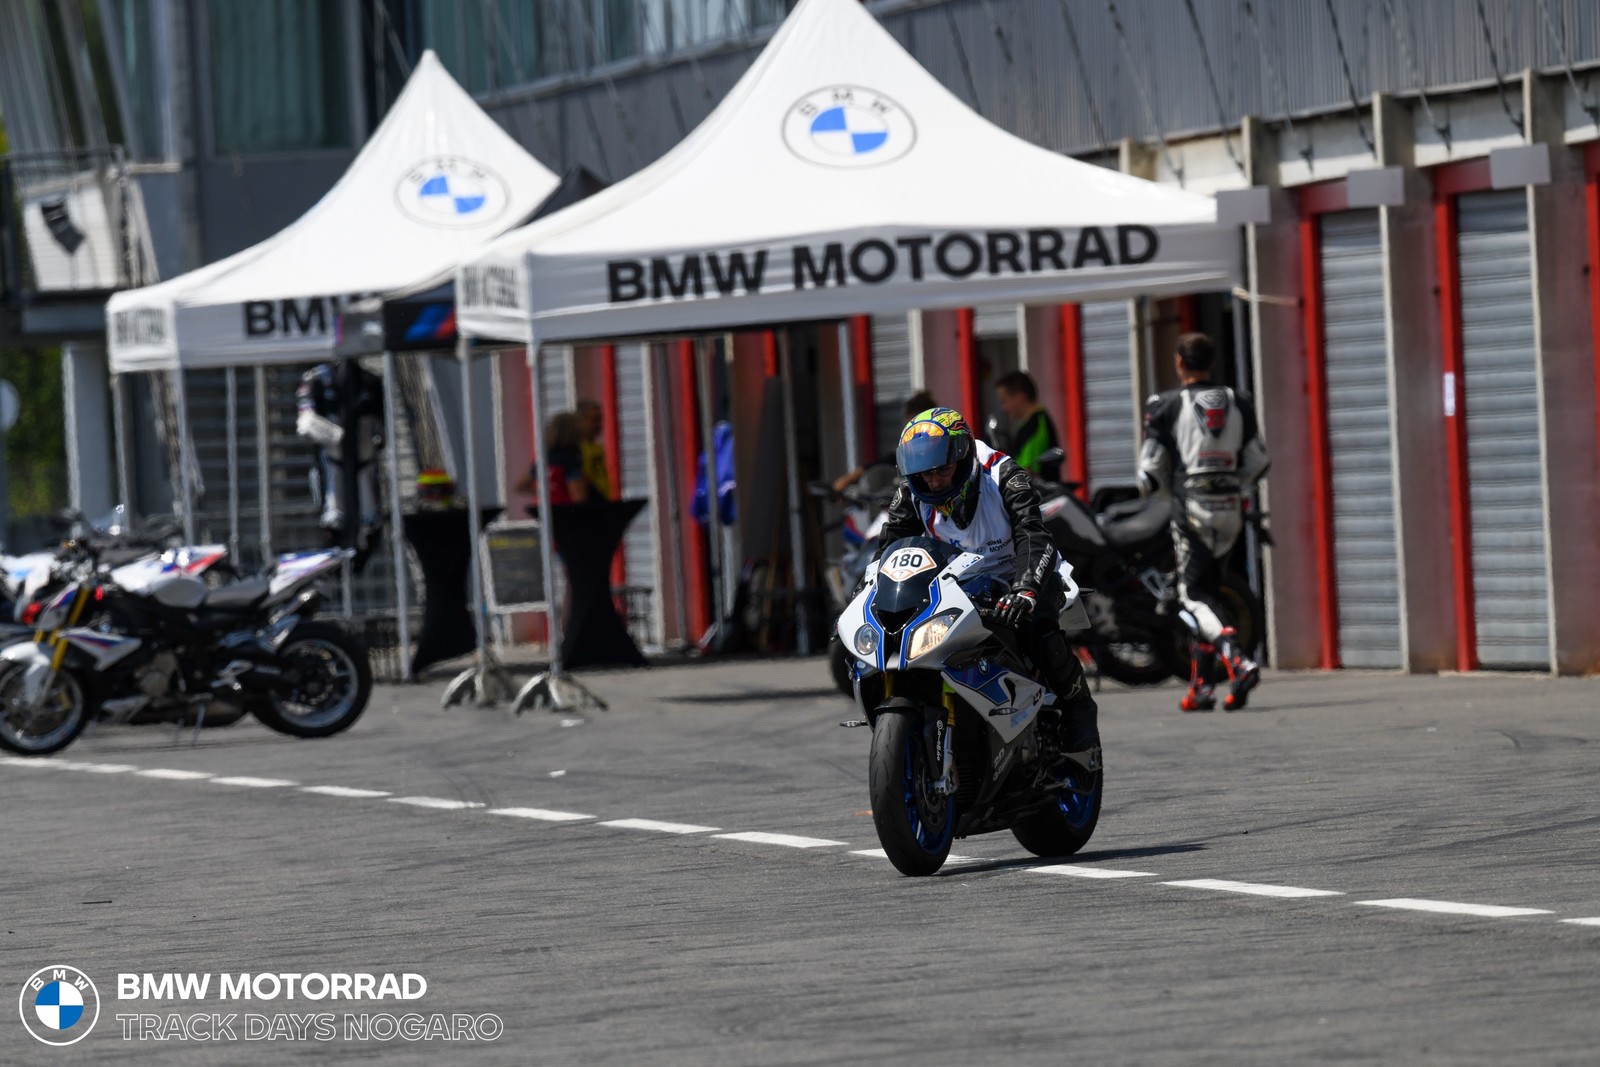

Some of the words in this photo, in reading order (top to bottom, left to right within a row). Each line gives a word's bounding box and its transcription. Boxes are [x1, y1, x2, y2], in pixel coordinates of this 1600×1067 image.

[606, 250, 768, 303] BMW
[791, 224, 1161, 289] MOTORRAD
[891, 553, 923, 569] 180
